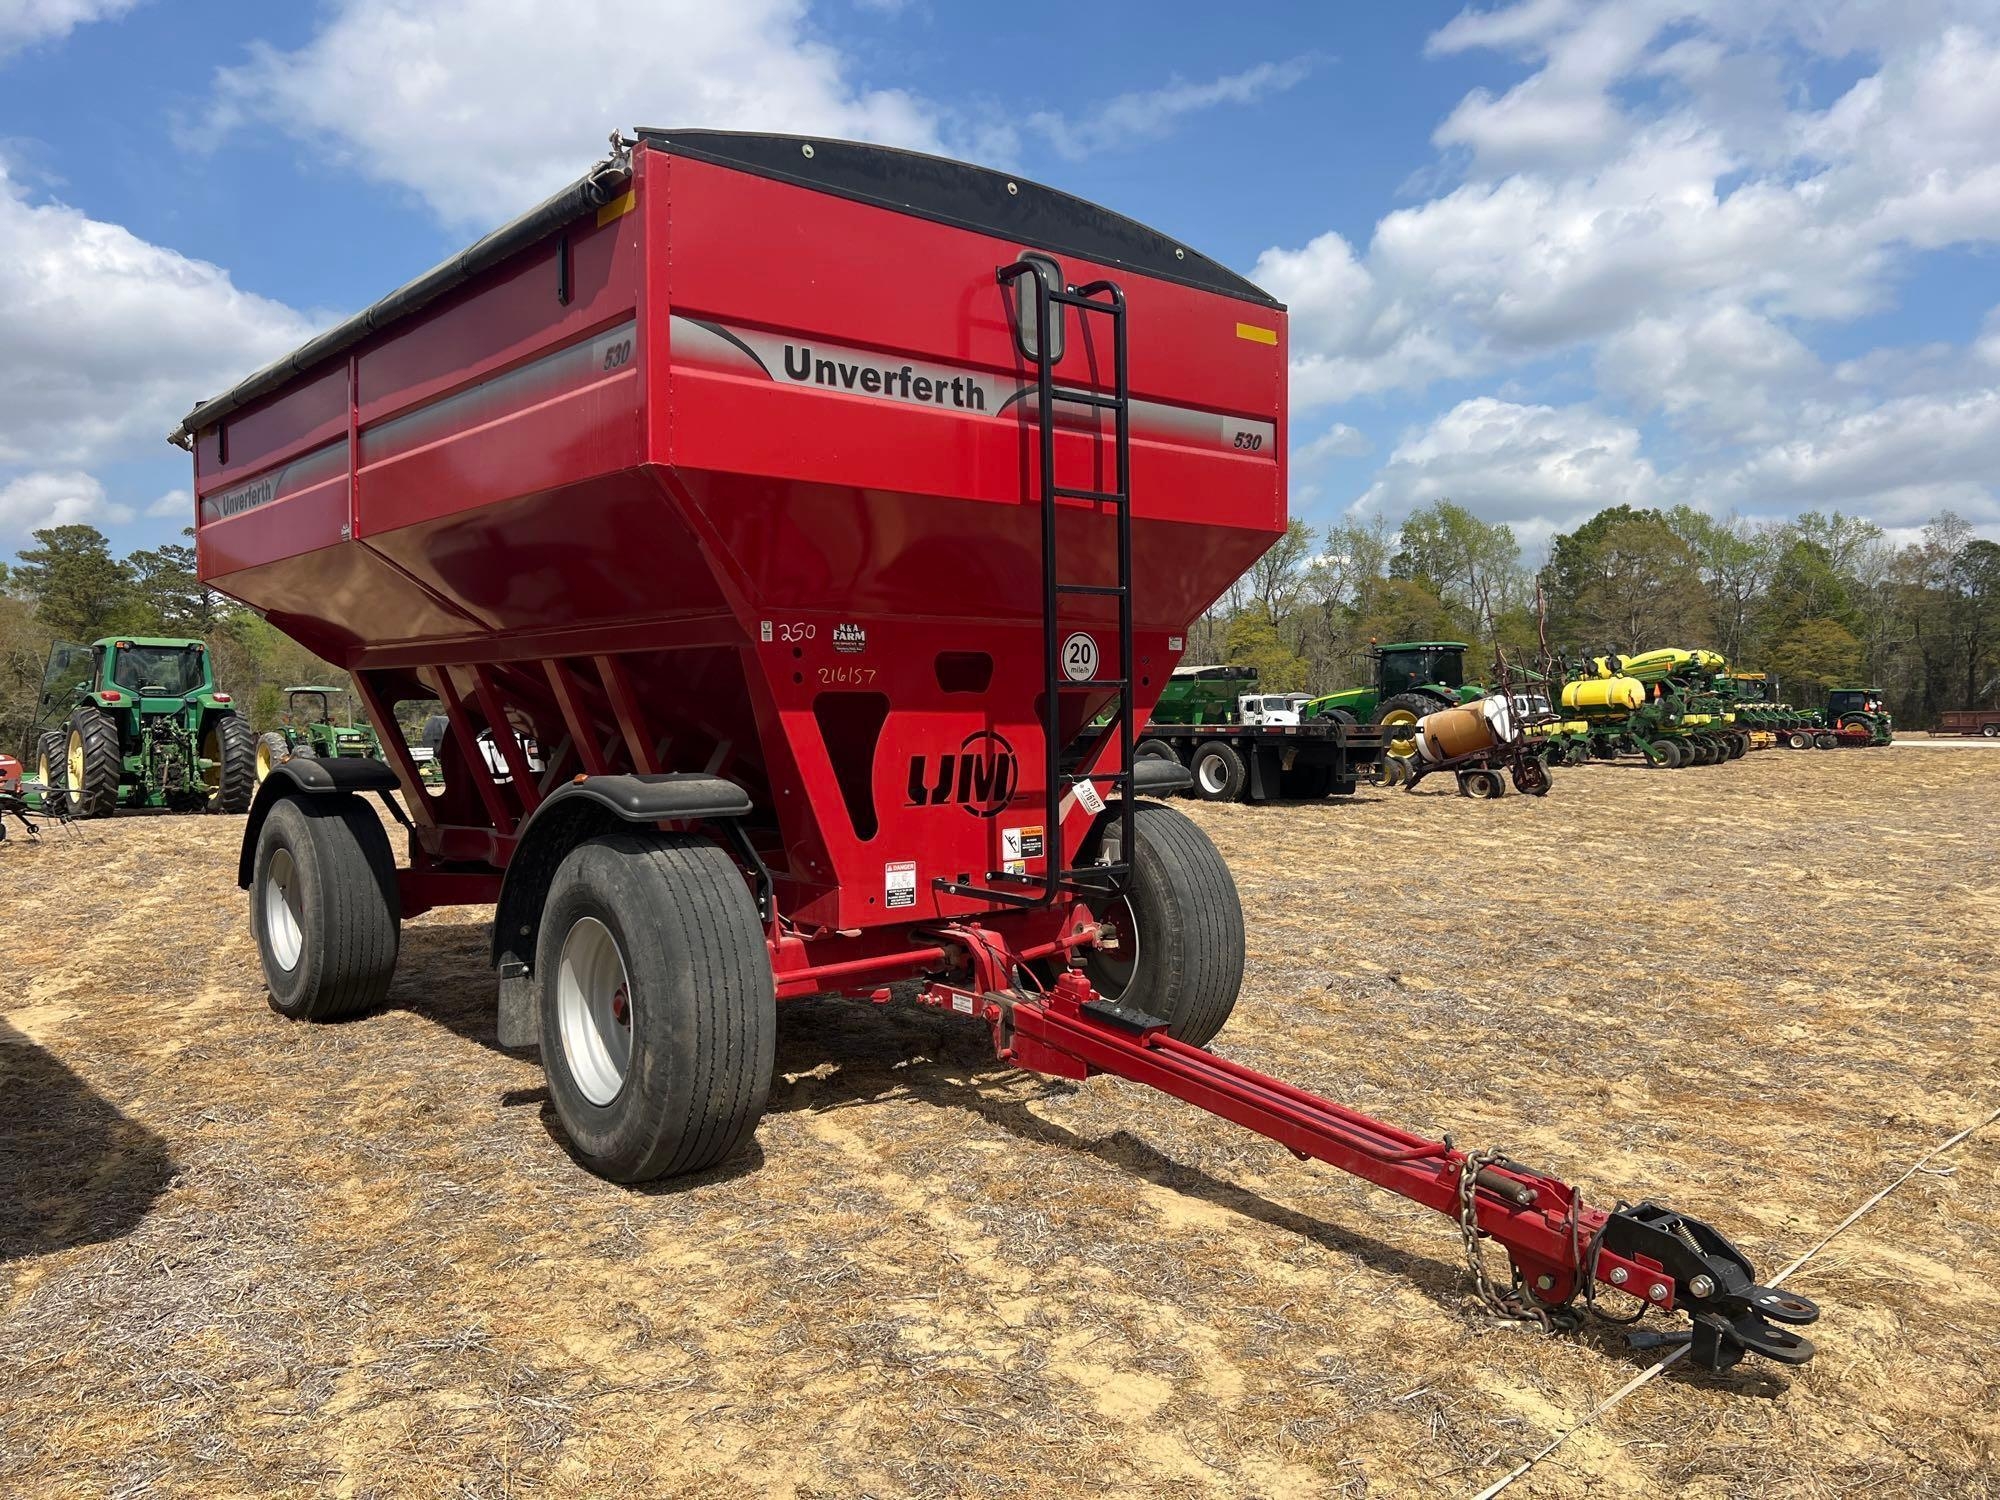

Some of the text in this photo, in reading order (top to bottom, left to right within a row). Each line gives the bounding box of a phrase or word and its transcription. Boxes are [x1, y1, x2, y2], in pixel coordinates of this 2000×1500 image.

[603, 339, 631, 371] 530
[784, 344, 986, 411] Unverferth
[1233, 431, 1262, 450] 530
[223, 479, 272, 516] Unverferth
[778, 622, 816, 642] 250
[833, 629, 865, 641] FARM
[1069, 643, 1091, 664] 20
[817, 667, 876, 685] 216157
[1082, 787, 1101, 810] 216157
